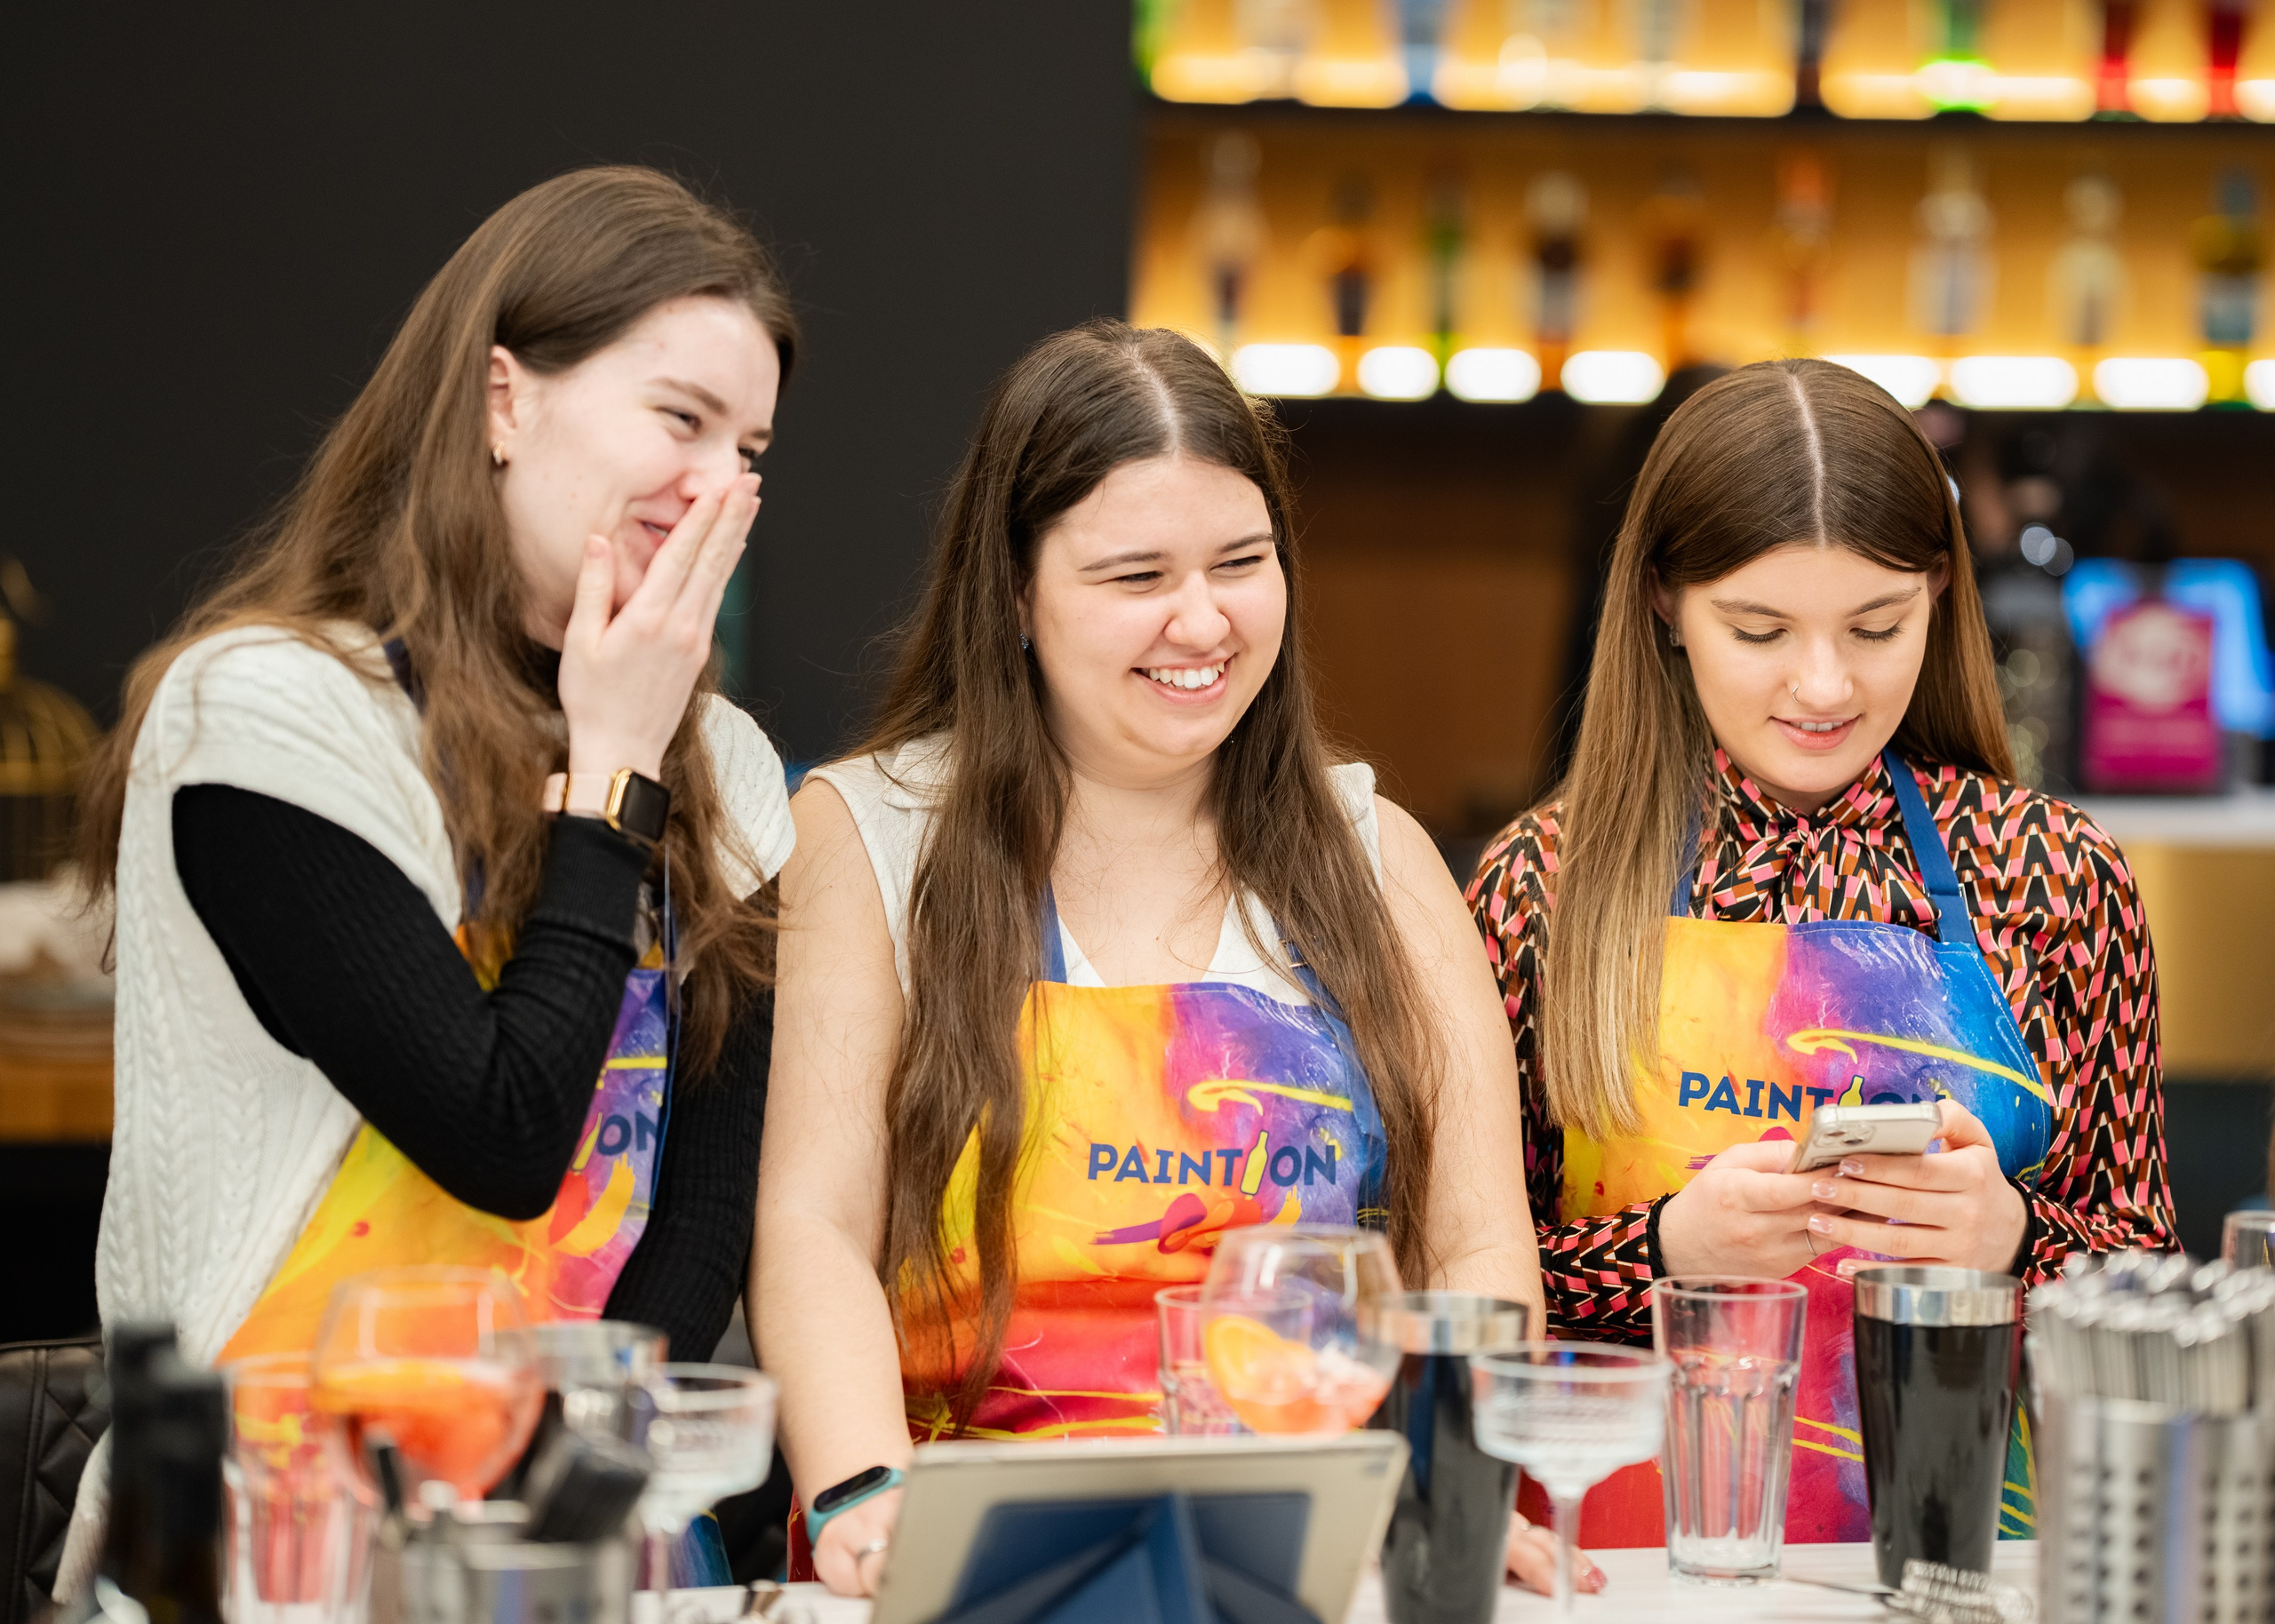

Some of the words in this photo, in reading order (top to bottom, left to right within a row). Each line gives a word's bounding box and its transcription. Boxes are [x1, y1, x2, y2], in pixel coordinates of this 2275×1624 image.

[1679, 1071, 1834, 1122] PAINT
[1088, 1142, 1243, 1187] PAINT
[1269, 1144, 1337, 1187] ON
